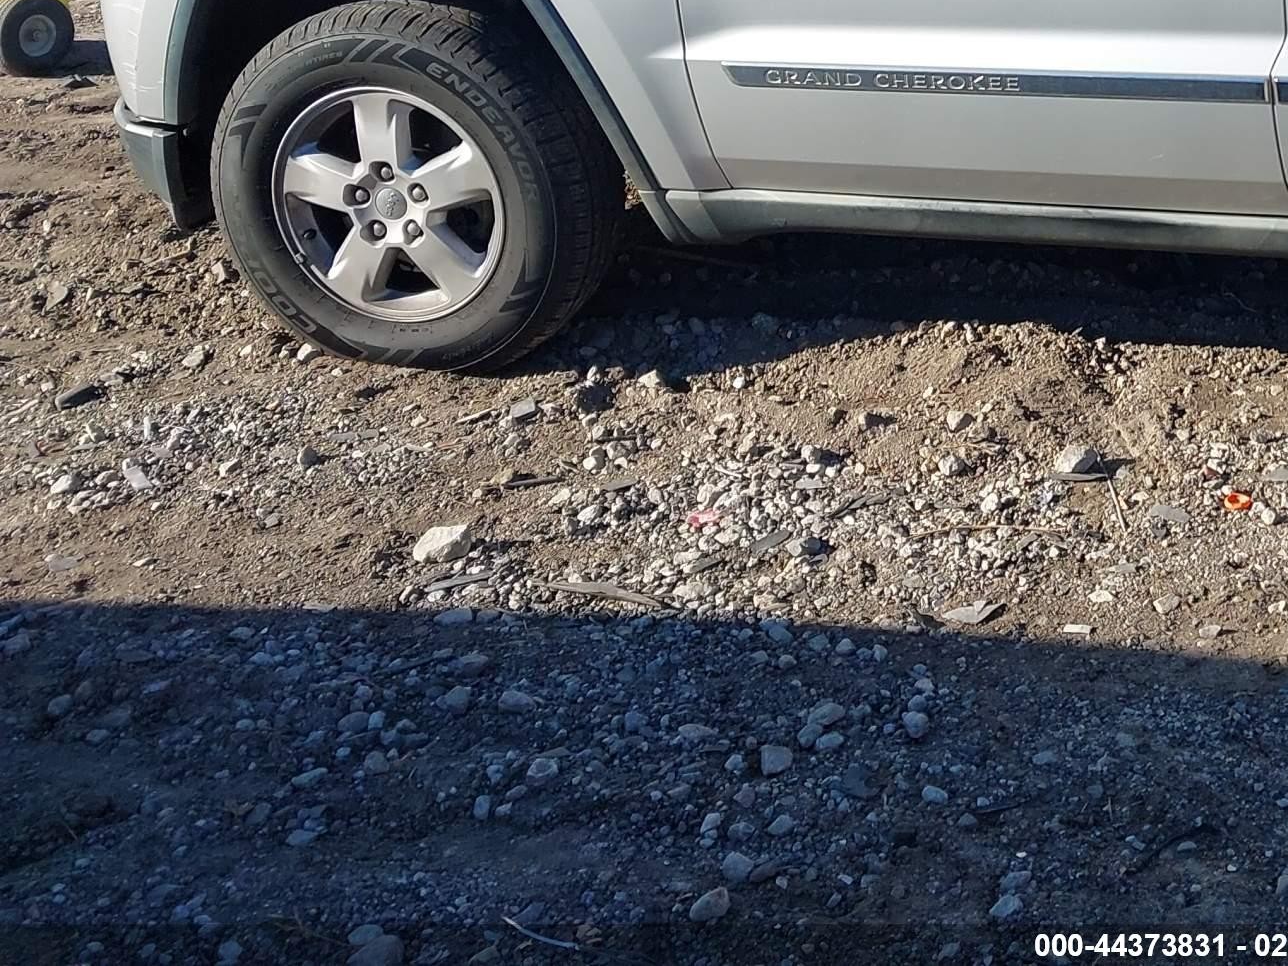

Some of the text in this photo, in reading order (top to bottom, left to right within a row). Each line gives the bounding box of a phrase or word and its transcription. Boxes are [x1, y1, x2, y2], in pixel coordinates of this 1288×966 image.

[765, 69, 1020, 93] GRAND CHEROKEE
[425, 61, 541, 201] ENDEAVOR
